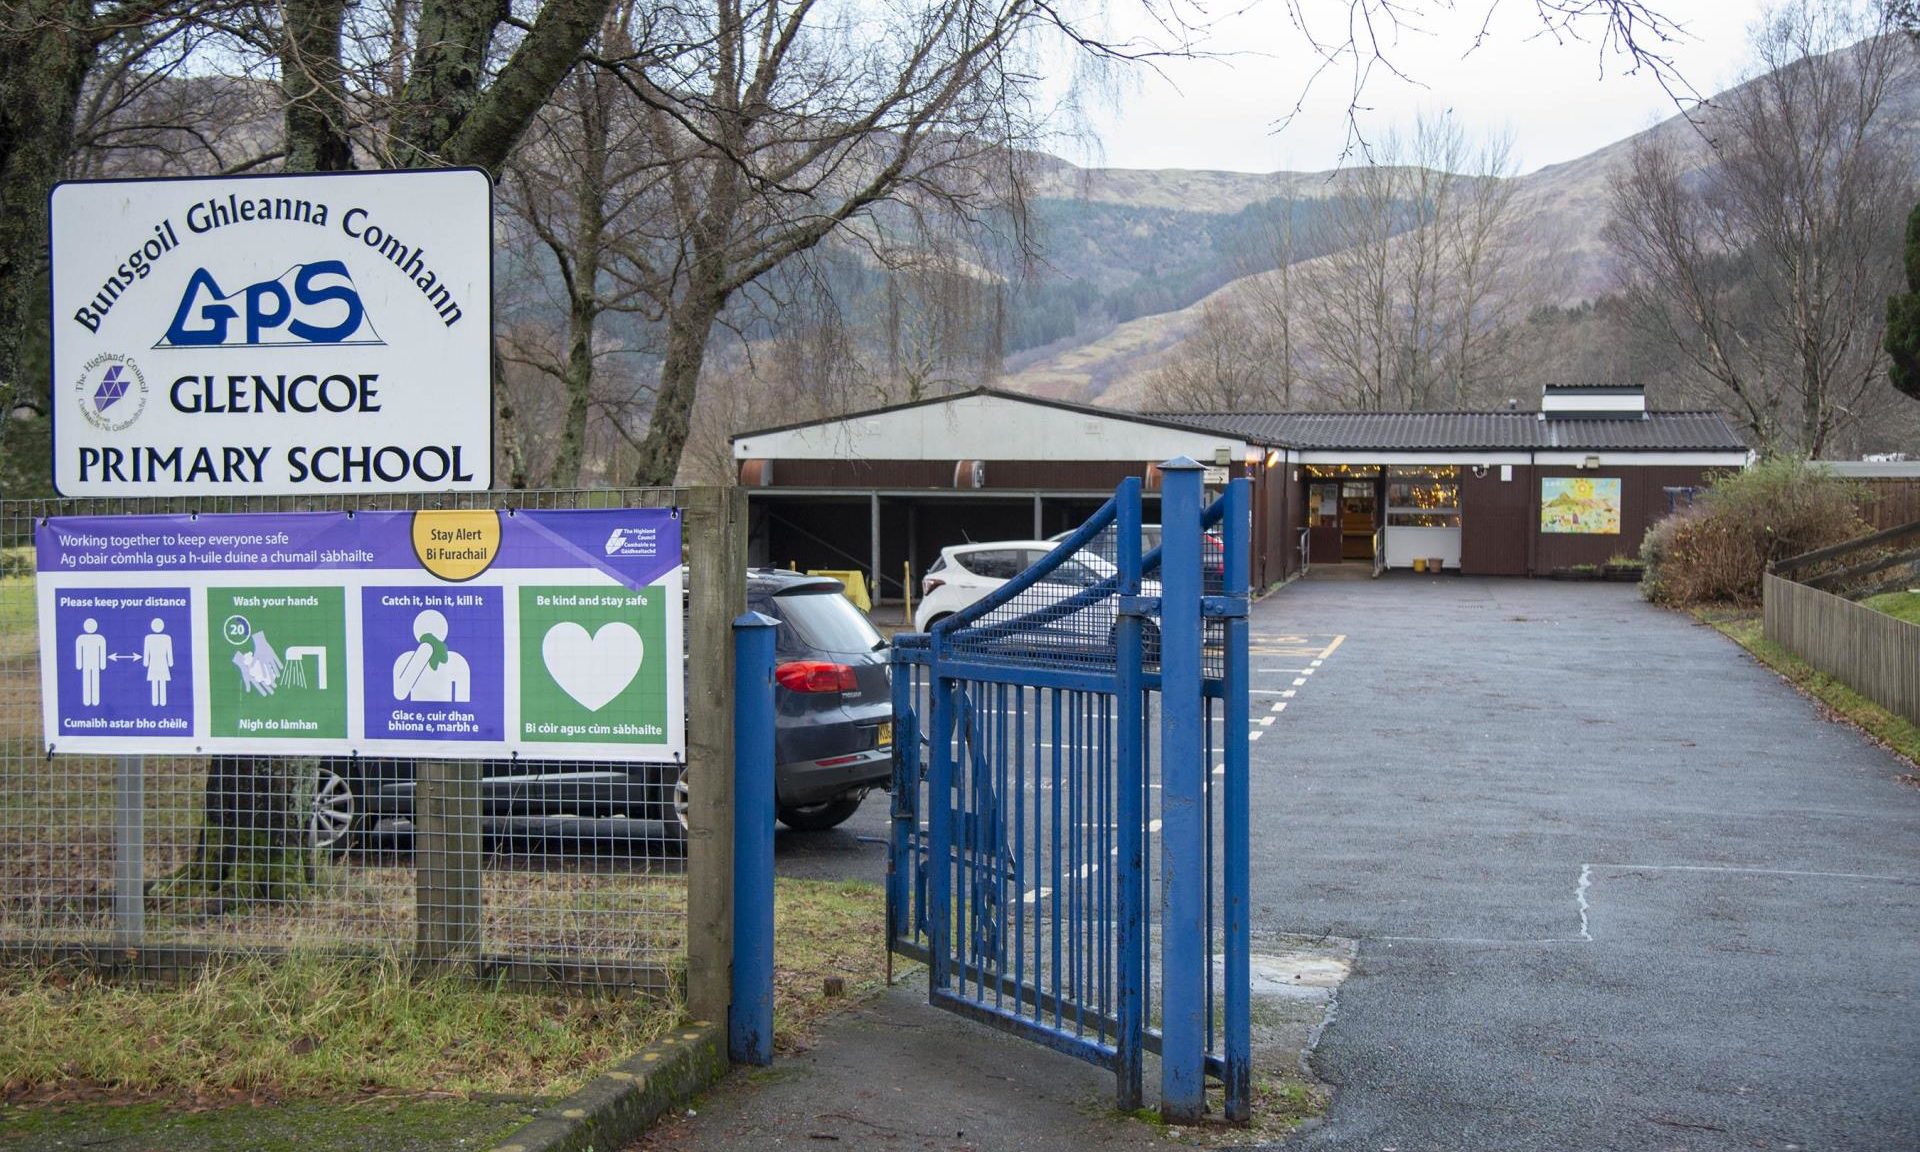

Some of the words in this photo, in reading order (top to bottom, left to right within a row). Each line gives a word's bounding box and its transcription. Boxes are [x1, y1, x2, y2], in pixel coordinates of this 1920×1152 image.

[74, 218, 179, 334] Bunsgoil
[187, 194, 329, 234] Ghleanna
[342, 207, 462, 328] Comhann
[75, 373, 87, 391] The
[83, 352, 125, 373] Highland
[126, 357, 149, 393] Council
[170, 374, 382, 413] GLENCOE
[79, 446, 271, 482] PRIMARY
[289, 445, 473, 482] SCHOOL
[59, 534, 108, 549] Working
[111, 533, 160, 549] together
[163, 535, 175, 546] to
[178, 533, 206, 547] keep
[209, 535, 263, 547] everyone
[265, 532, 289, 544] safe
[431, 529, 454, 543] Stay
[456, 528, 482, 540] Alert
[60, 553, 76, 567] Ag
[79, 552, 108, 564] obair
[111, 551, 154, 564] còmhla
[156, 554, 177, 566] gus
[180, 554, 186, 563] a
[189, 551, 222, 563] h-uile
[224, 551, 258, 563] duine
[261, 553, 268, 563] a
[270, 550, 317, 562] chumail
[320, 549, 374, 562] sàbhailte
[426, 548, 437, 560] Bi
[440, 547, 487, 560] Furachail
[60, 597, 93, 607] Please
[94, 597, 119, 608] keep
[120, 599, 143, 609] your
[145, 597, 186, 607] distance
[233, 596, 260, 606] Wash
[262, 598, 286, 608] your
[287, 596, 319, 606] hands
[382, 595, 411, 606] Catch
[412, 595, 423, 607] it,
[425, 595, 442, 606] bin
[444, 595, 455, 607] it,
[457, 595, 473, 605] kill
[475, 595, 483, 605] it
[536, 595, 551, 606] Be
[552, 595, 576, 606] kind
[578, 595, 599, 606] and
[601, 596, 624, 608] stay
[625, 595, 648, 606] safe
[230, 624, 245, 635] 20
[392, 710, 415, 720] Glac
[416, 712, 425, 722] e,
[427, 711, 447, 721] cuir
[448, 711, 475, 722] dhan
[64, 718, 108, 728] Cumaibh
[109, 719, 135, 728] astar
[136, 718, 157, 728] bho
[158, 718, 188, 728] chèile
[240, 719, 263, 731] Nigh
[265, 719, 279, 729] do
[280, 719, 318, 730] làmhan
[388, 720, 424, 732] bhiona
[425, 723, 435, 733] e,
[436, 722, 470, 732] marbh
[472, 724, 479, 733] e
[525, 723, 536, 733] Bi
[538, 722, 559, 733] còir
[560, 724, 586, 736] agus
[588, 723, 610, 734] cùm
[612, 724, 663, 735] sàbhailte
